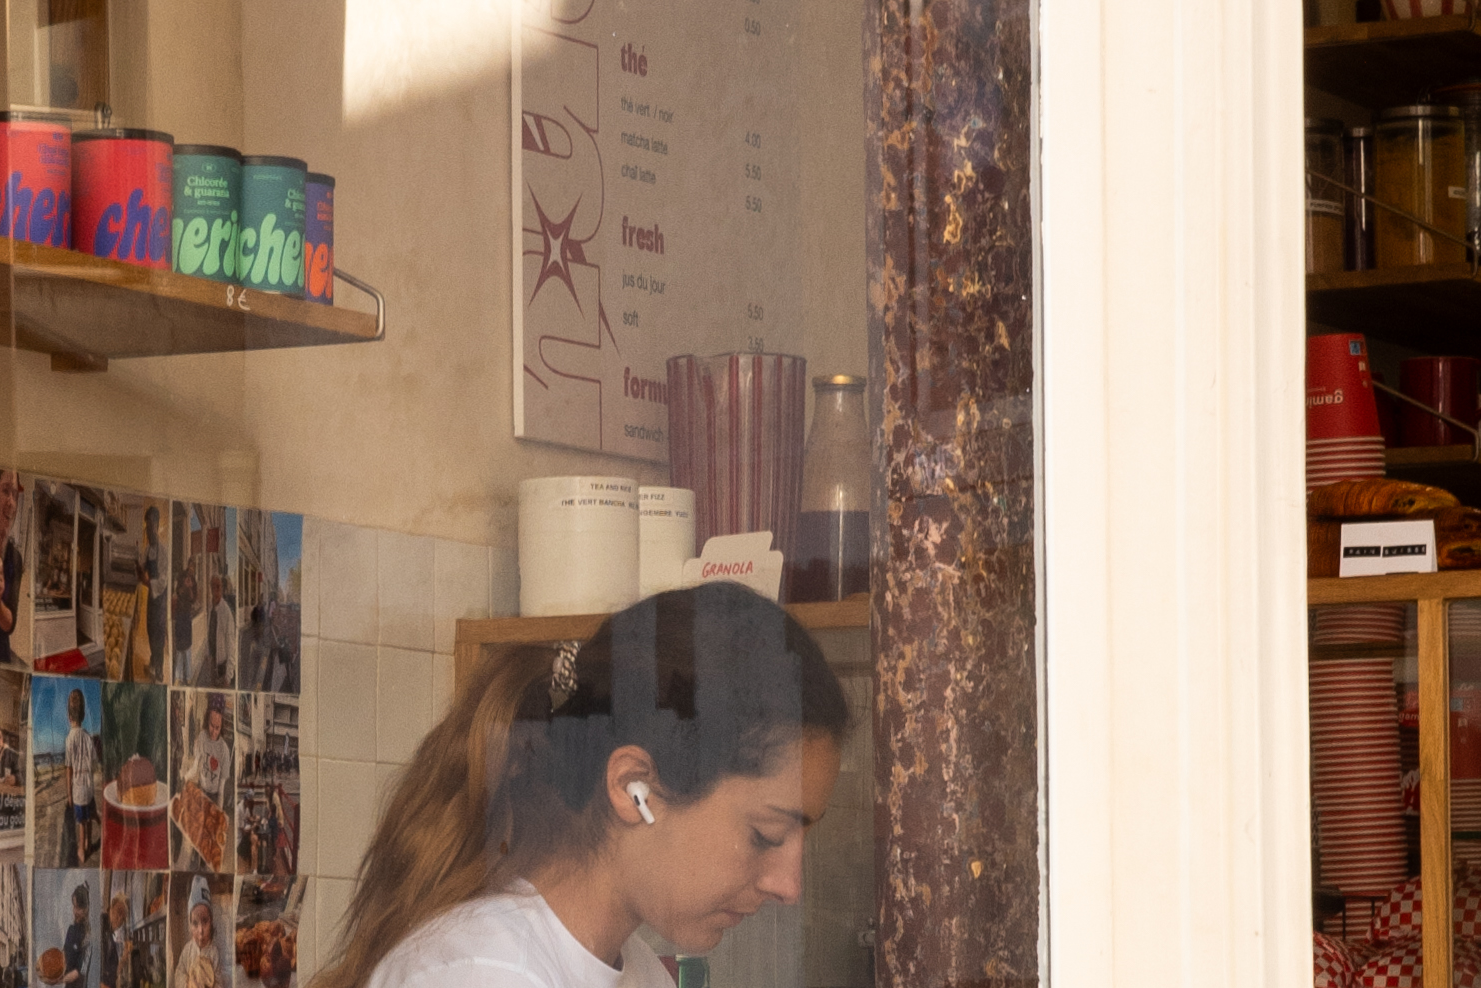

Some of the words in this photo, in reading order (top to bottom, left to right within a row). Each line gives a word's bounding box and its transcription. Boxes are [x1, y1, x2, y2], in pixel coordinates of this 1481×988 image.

[621, 43, 648, 77] thé
[622, 215, 665, 255] fresh
[622, 272, 635, 289] jus
[637, 273, 648, 291] du
[649, 275, 666, 295] jour
[622, 310, 639, 327] soft
[624, 424, 664, 442] sandwich
[702, 561, 754, 578] GRANOLA
